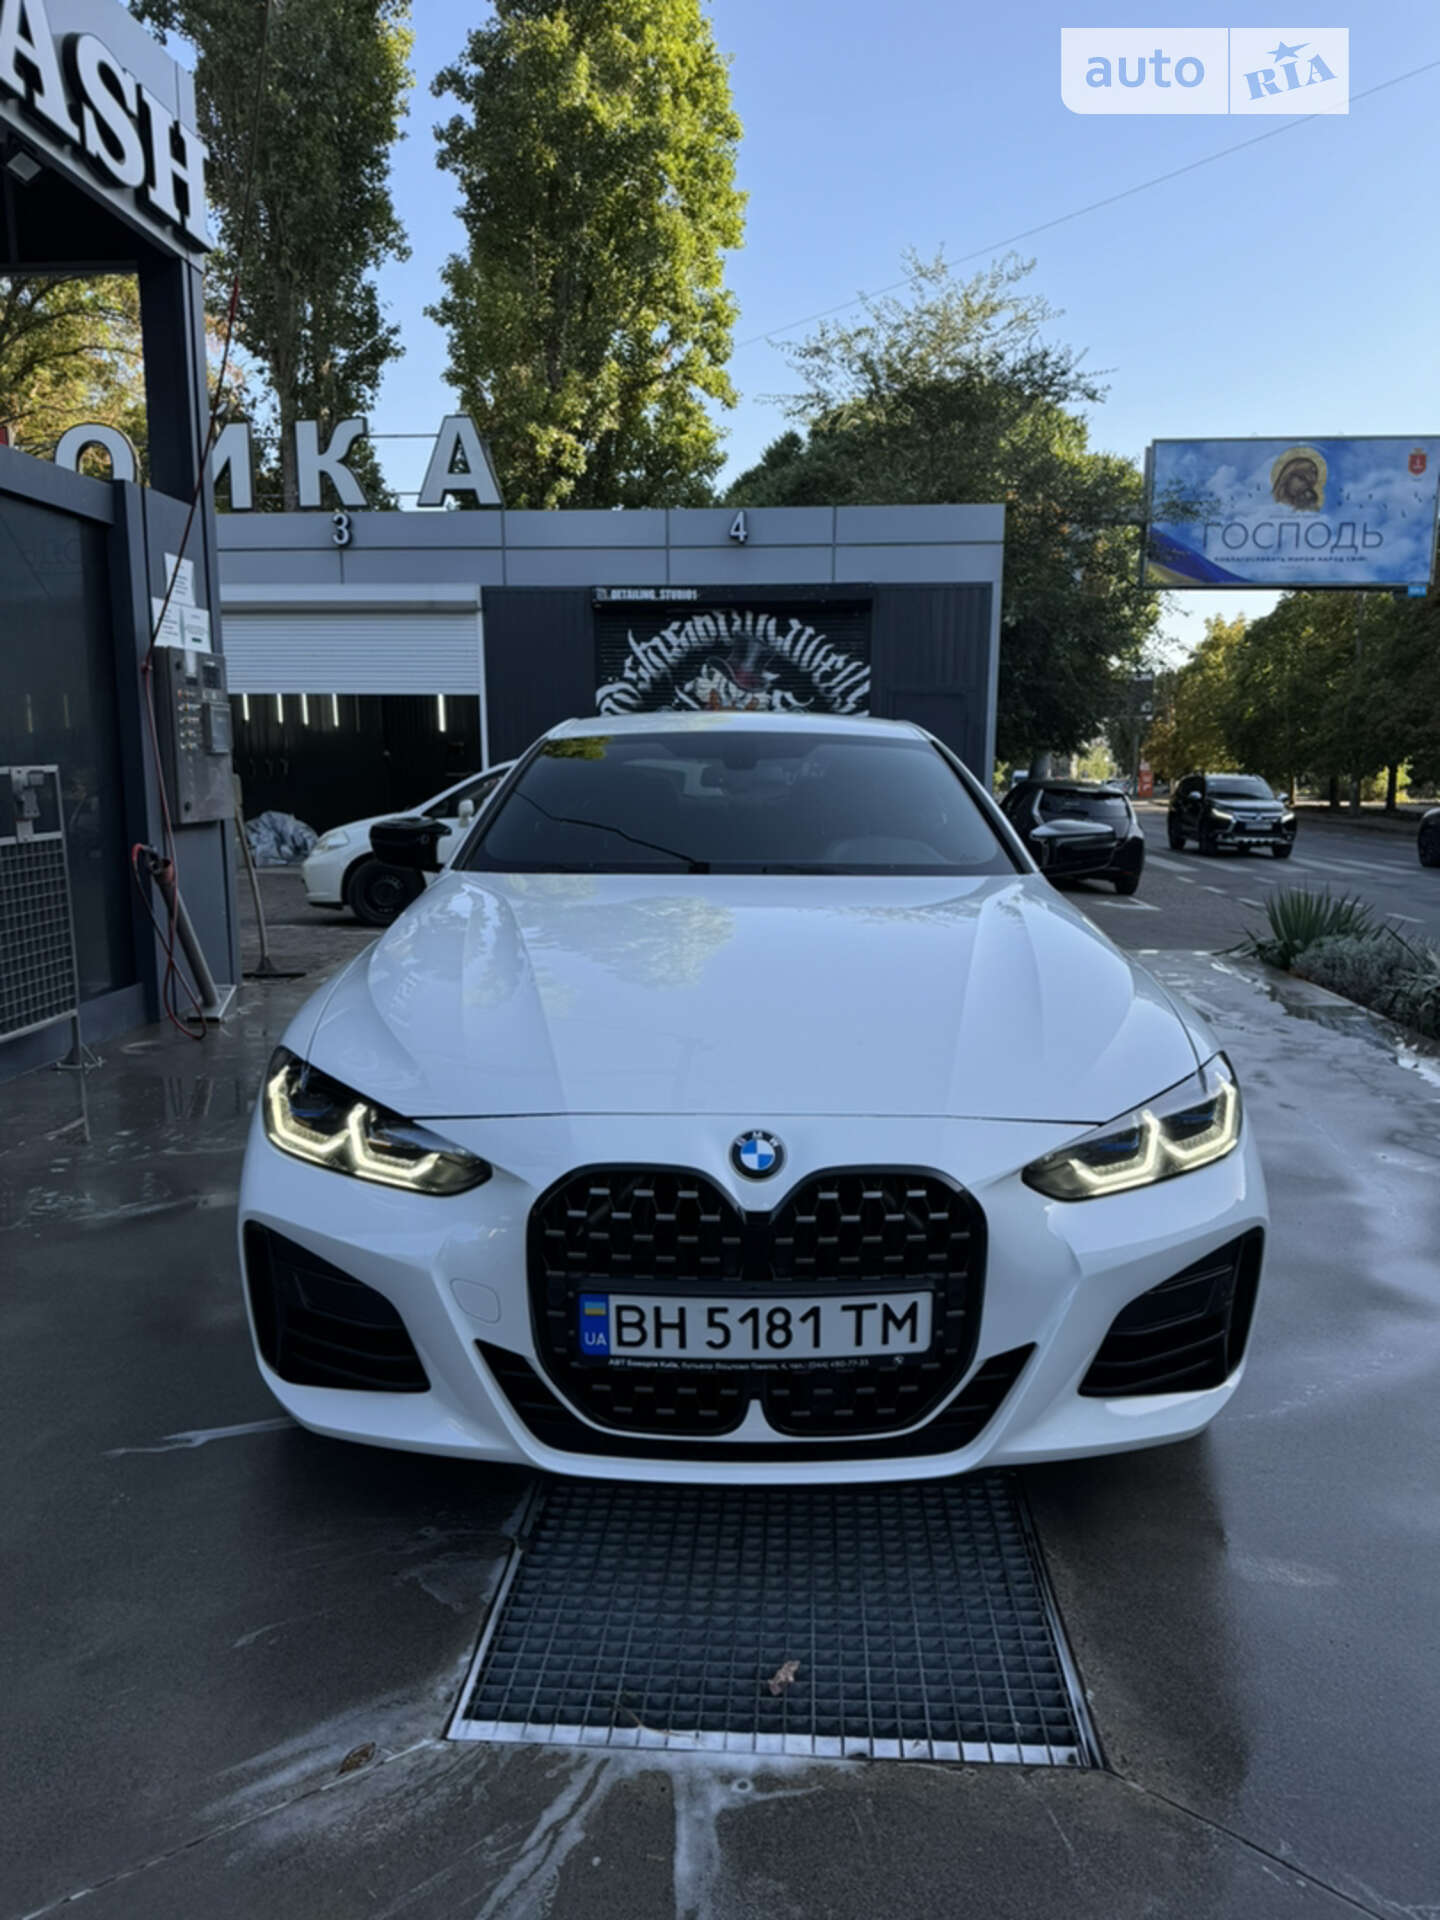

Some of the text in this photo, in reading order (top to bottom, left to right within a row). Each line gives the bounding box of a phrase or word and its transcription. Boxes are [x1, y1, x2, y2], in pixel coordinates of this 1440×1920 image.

[332, 513, 352, 546] 3
[729, 510, 748, 543] 4
[1202, 521, 1384, 553] ГОСПОДЬ
[584, 1332, 608, 1346] UA
[706, 1306, 821, 1350] 5181
